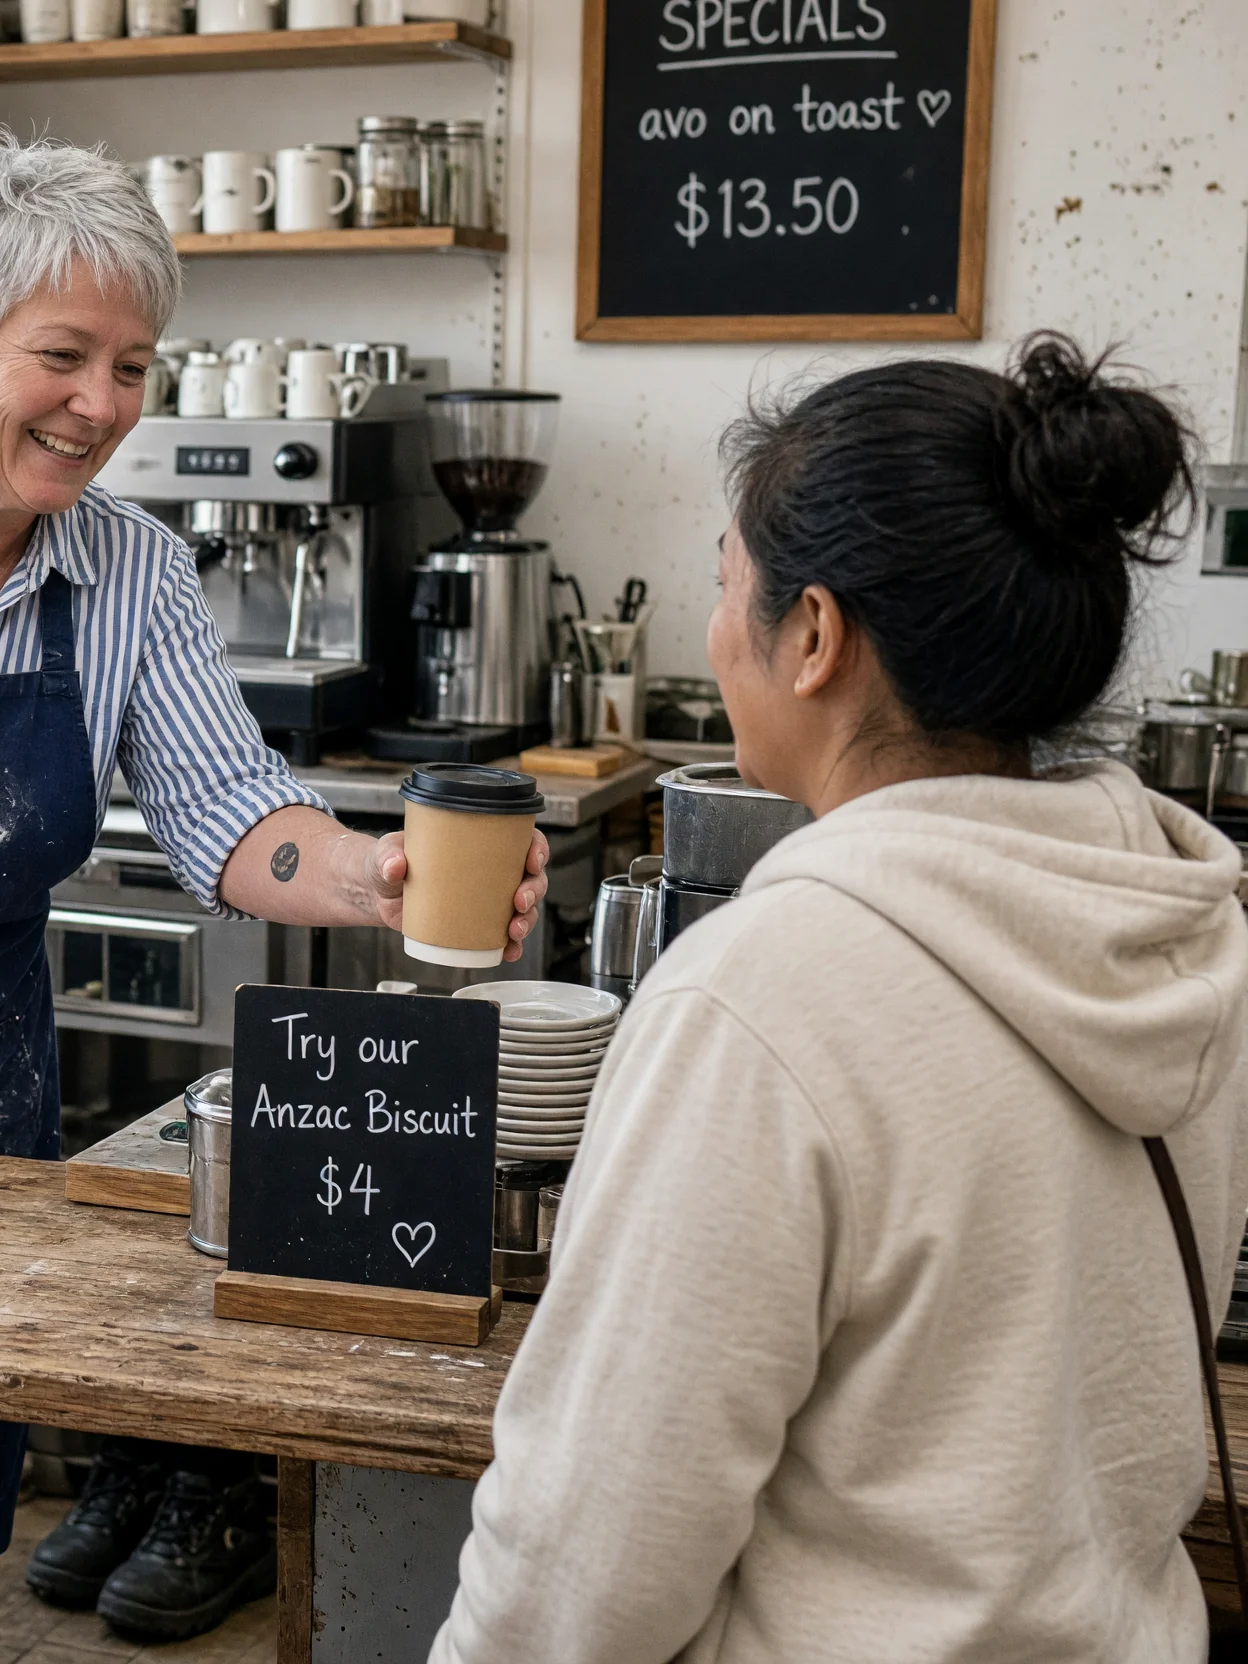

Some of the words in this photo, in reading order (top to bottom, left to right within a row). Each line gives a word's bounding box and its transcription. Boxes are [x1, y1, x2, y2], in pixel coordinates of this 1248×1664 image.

[658, 0, 887, 52] SPECIALS
[638, 106, 707, 141] avo
[728, 104, 776, 136] on
[793, 81, 905, 133] toast
[674, 172, 859, 248] $13.50
[271, 1012, 336, 1081] Try
[358, 1036, 420, 1065] our
[250, 1083, 352, 1130] Anzac
[364, 1088, 479, 1138] Biscuit
[316, 1155, 381, 1216] $4
